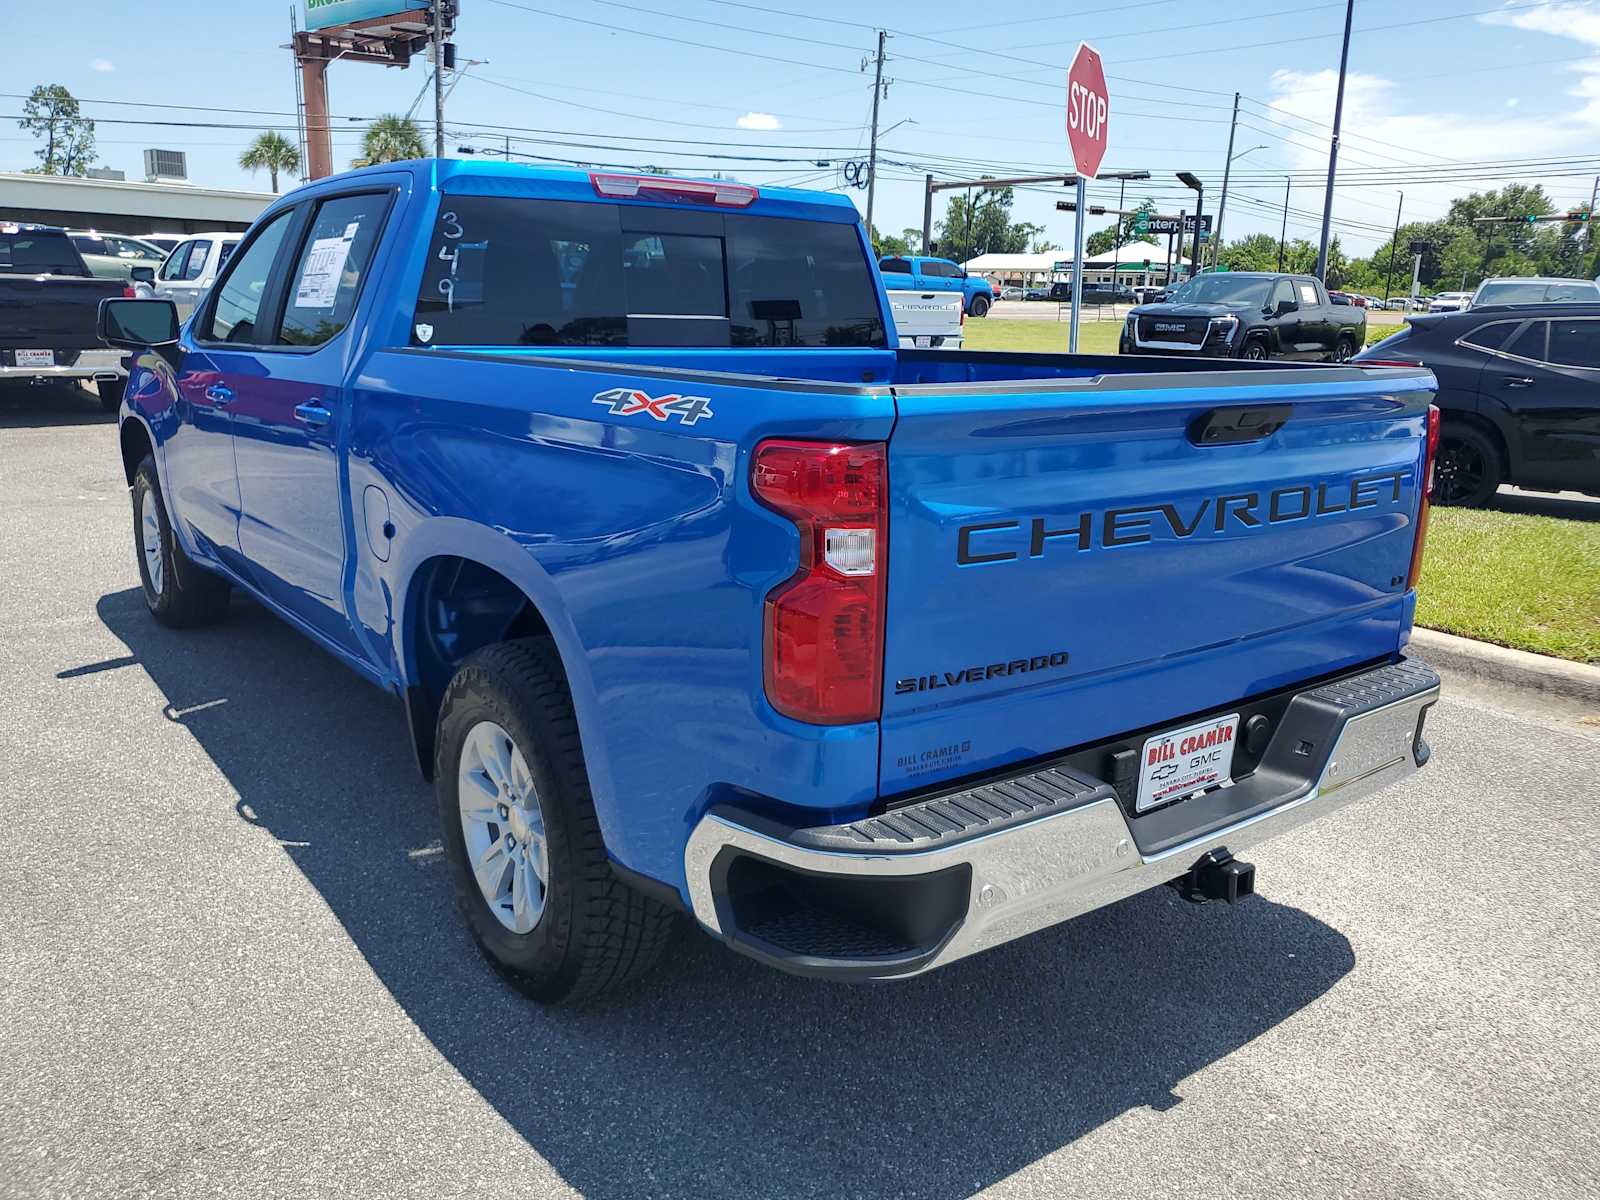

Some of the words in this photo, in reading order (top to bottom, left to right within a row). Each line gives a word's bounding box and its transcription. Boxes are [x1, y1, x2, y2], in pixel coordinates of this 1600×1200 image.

[1069, 81, 1106, 141] STOP
[894, 304, 957, 312] CHEVROLET
[1154, 323, 1186, 332] GMC
[957, 471, 1411, 567] CHEVROLET
[895, 652, 1069, 695] SILVERADO
[897, 754, 917, 768] BILL
[921, 743, 959, 761] CRAMER
[1148, 743, 1175, 766] BILL
[1180, 726, 1233, 756] CRAMER
[1190, 750, 1222, 769] GMC
